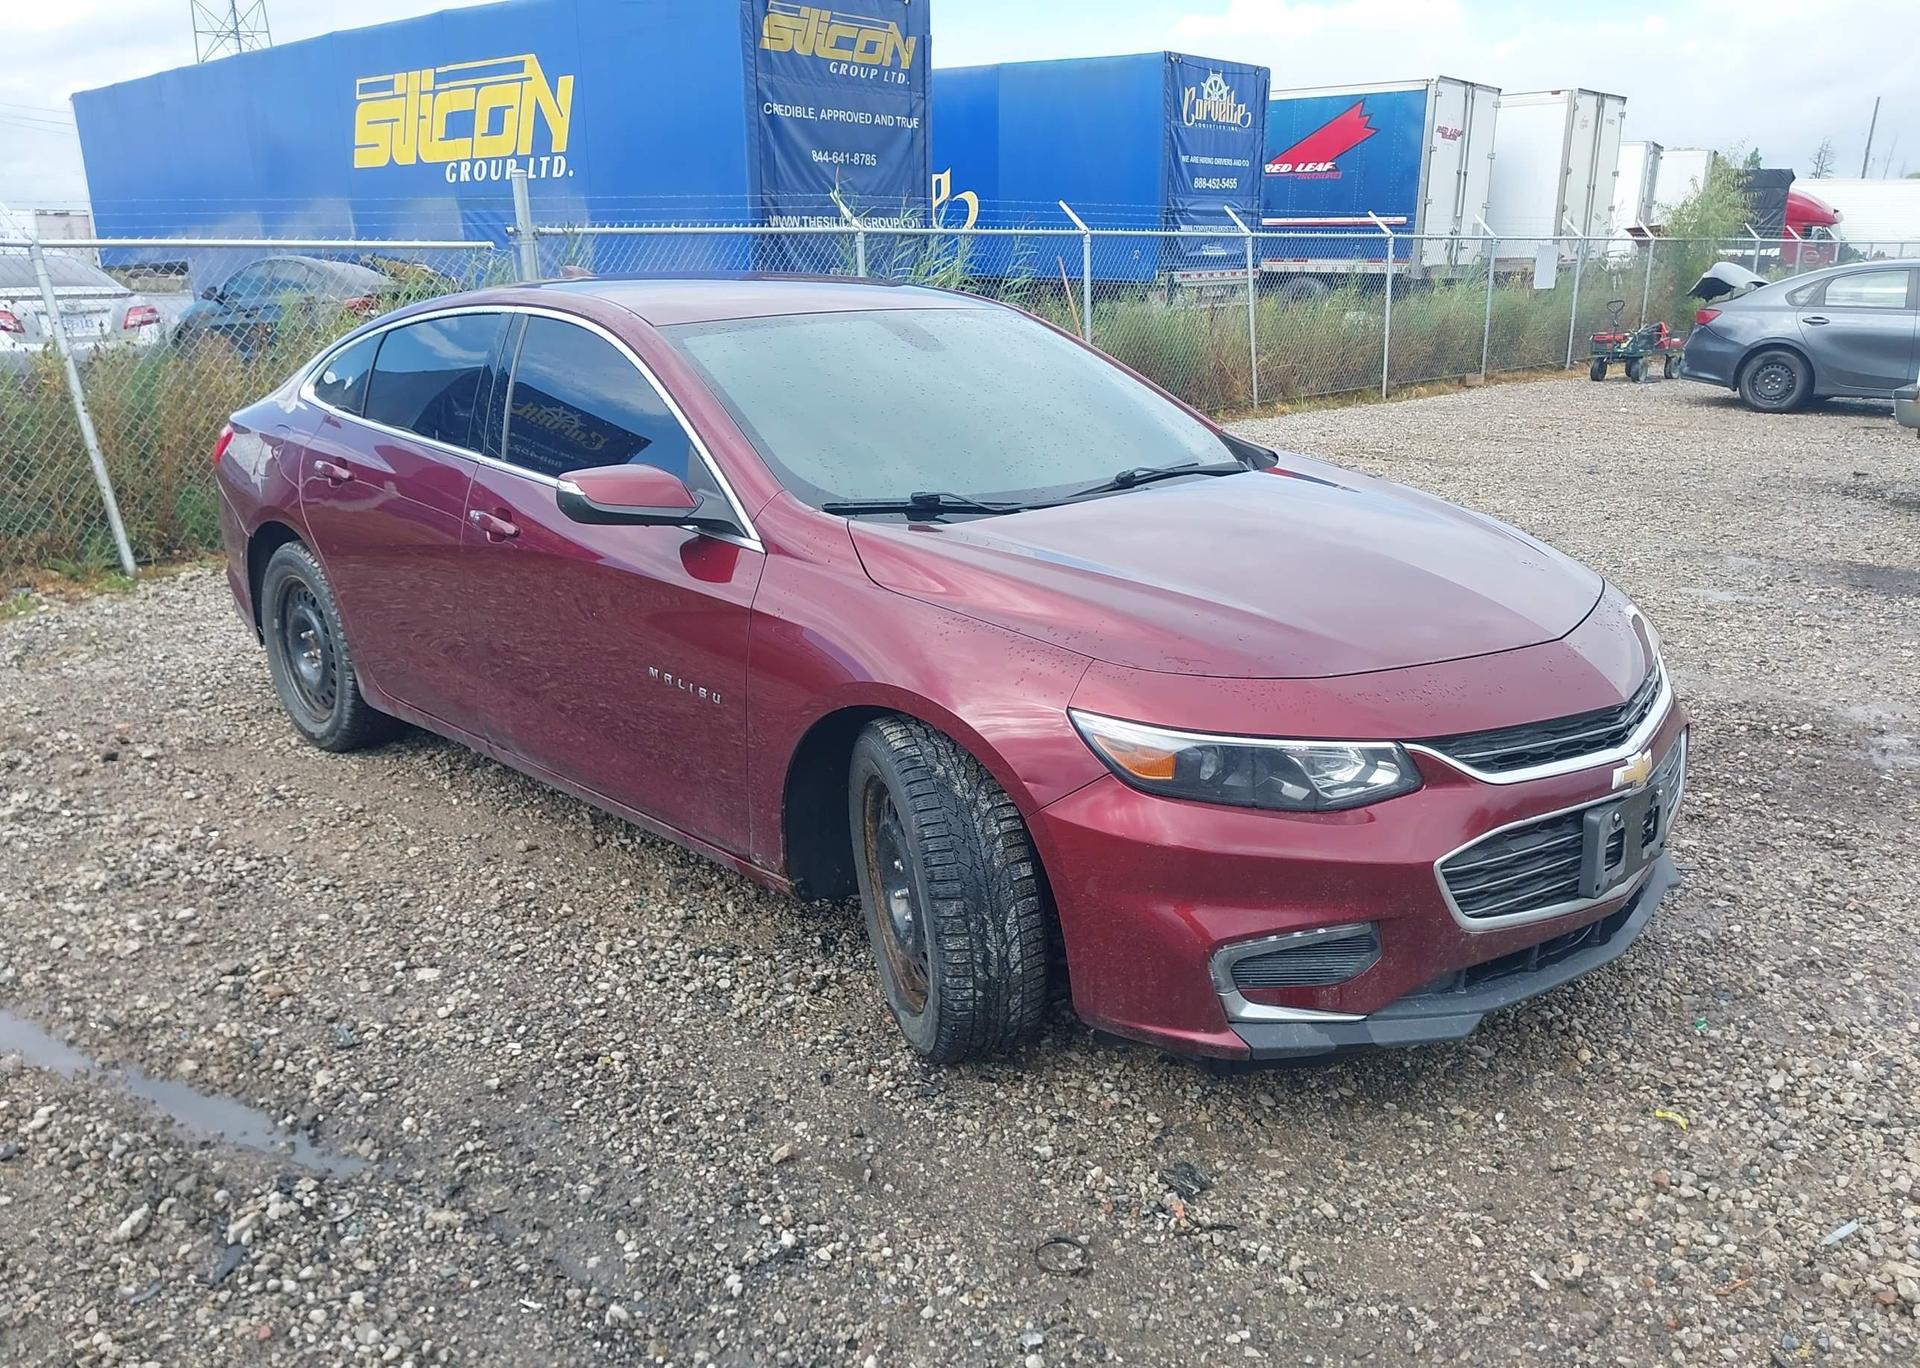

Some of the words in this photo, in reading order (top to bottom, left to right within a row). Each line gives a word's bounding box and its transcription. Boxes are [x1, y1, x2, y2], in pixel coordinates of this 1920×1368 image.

[829, 61, 878, 80] GROUP
[884, 70, 911, 85] LTD.
[763, 102, 818, 121] CREDIBLE,
[819, 109, 872, 125] APPROVED
[874, 114, 894, 127] AND
[896, 116, 919, 129] TRUE
[445, 158, 517, 183] GROUP
[527, 155, 575, 179] LTD.
[811, 150, 877, 166] 844-641-8785
[1264, 163, 1293, 173] RED
[1294, 162, 1336, 173] LEAF
[648, 666, 721, 704] MALIBU
